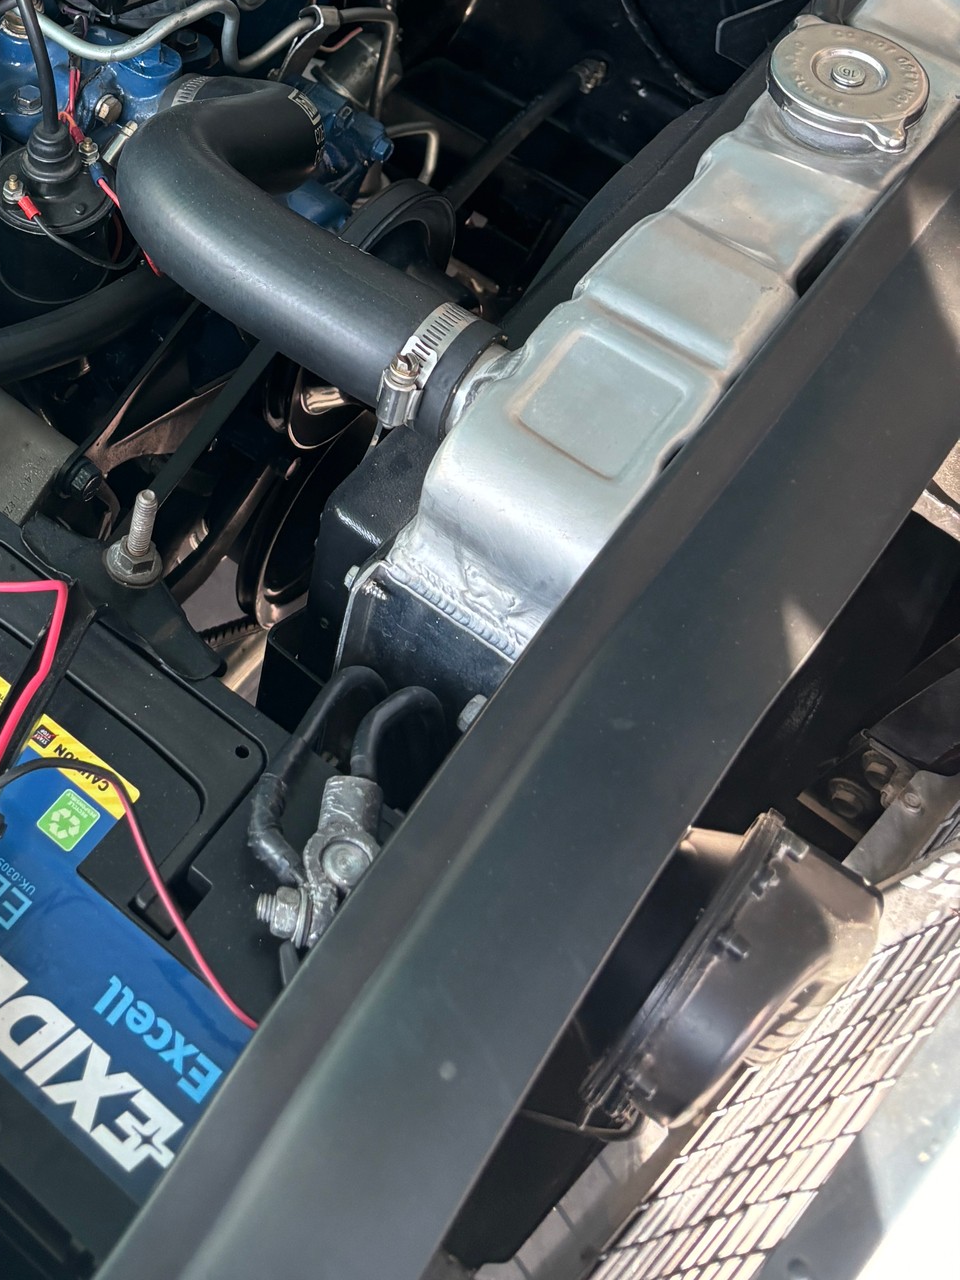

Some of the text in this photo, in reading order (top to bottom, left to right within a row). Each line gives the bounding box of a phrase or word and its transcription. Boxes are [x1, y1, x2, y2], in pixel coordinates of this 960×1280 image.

[842, 68, 857, 78] 16
[66, 790, 98, 819] RESPONSIBLY
[68, 800, 89, 818] RECYCLE
[93, 975, 222, 1105] Excell
